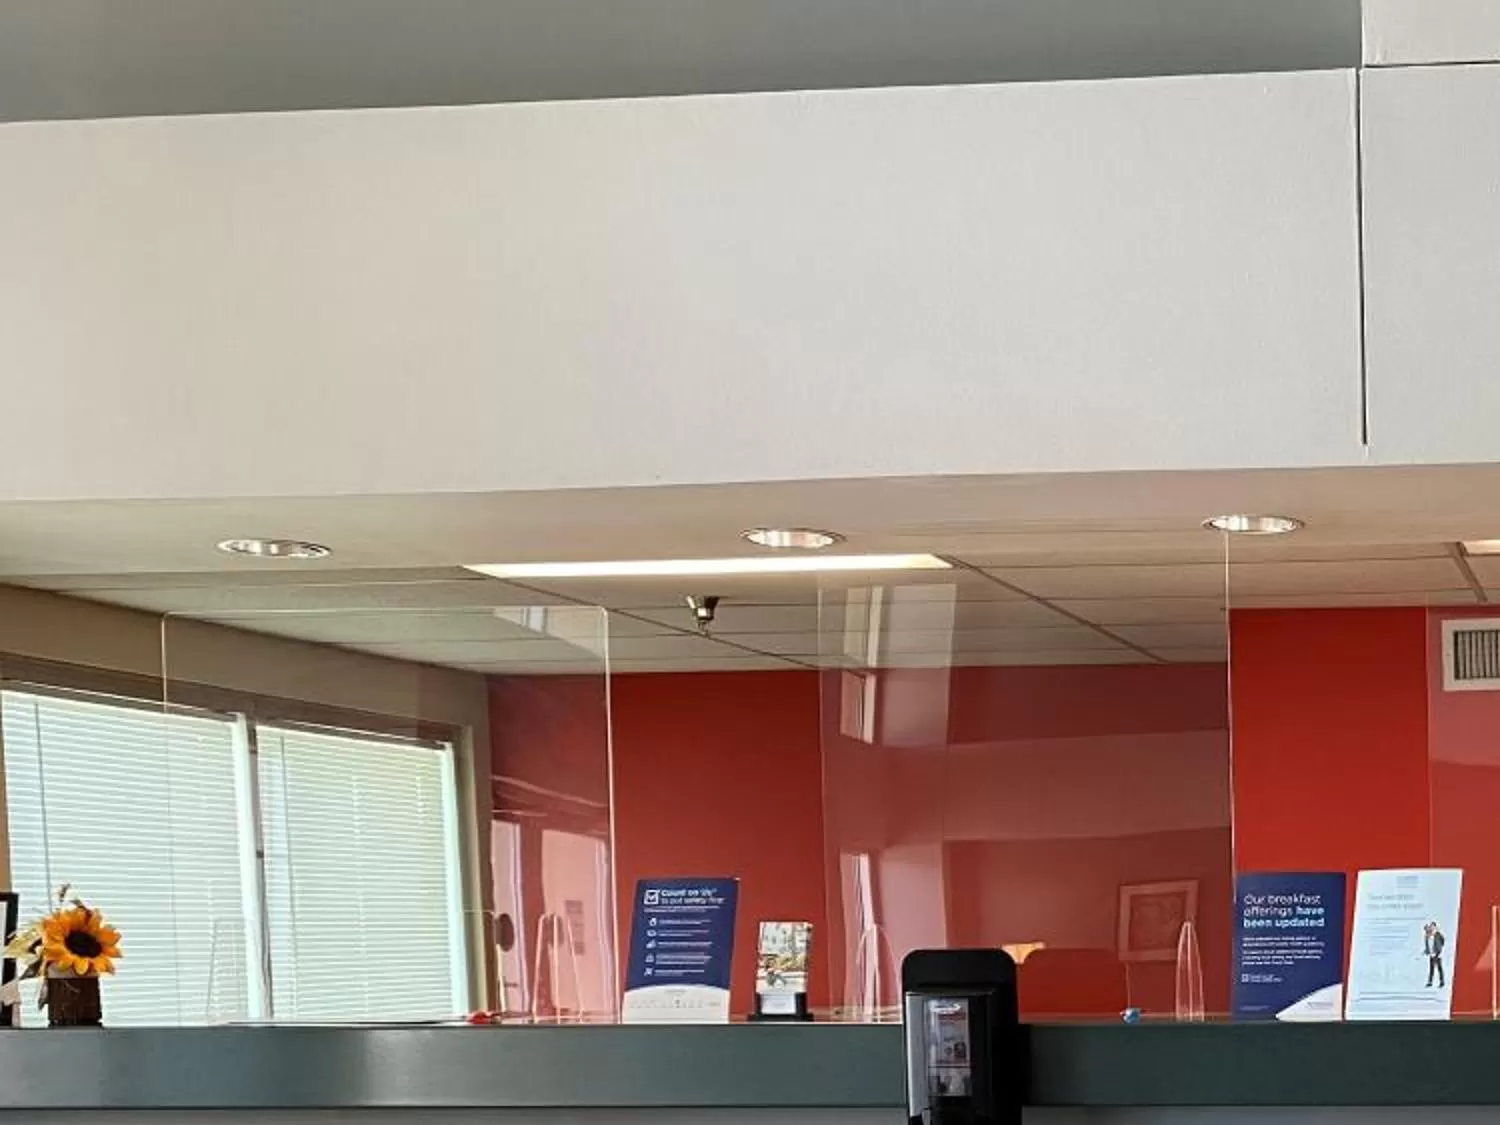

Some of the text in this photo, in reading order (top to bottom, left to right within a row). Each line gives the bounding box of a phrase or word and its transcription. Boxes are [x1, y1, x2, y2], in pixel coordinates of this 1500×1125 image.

[1243, 893, 1321, 905] Our breakfast
[1243, 905, 1325, 918] offerings have
[1243, 917, 1325, 928] been updated
